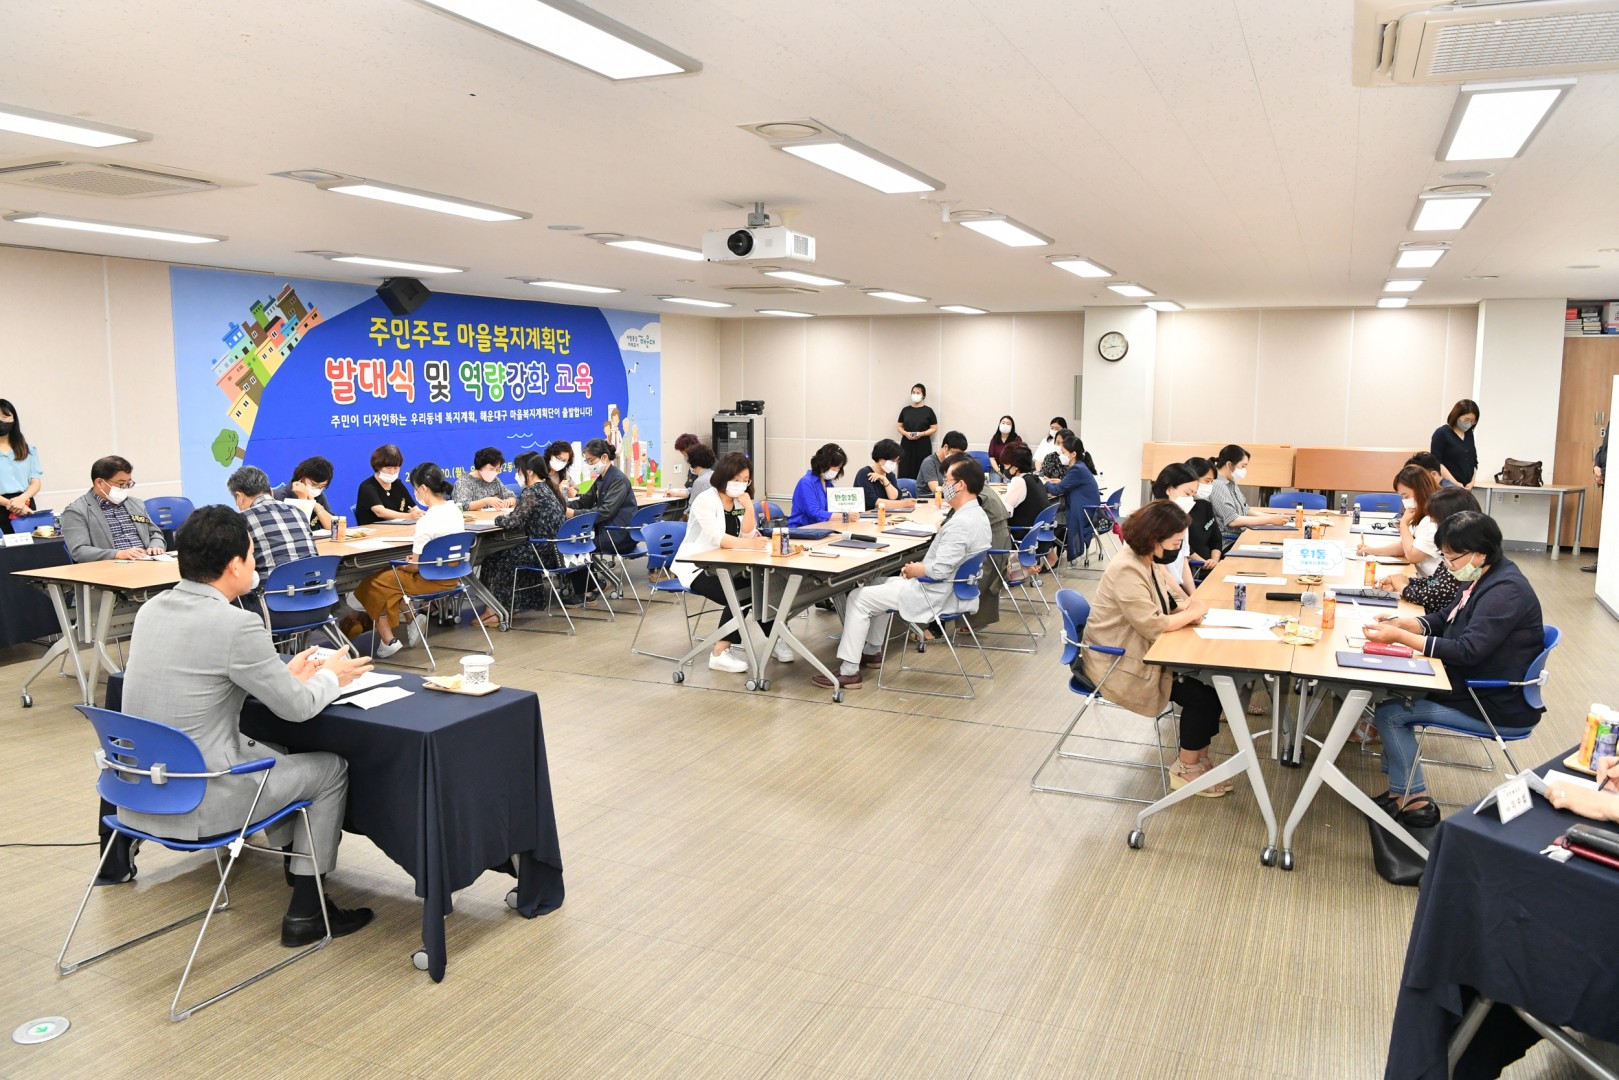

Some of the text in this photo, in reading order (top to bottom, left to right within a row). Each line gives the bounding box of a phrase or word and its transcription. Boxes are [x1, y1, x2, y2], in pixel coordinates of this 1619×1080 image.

[369, 317, 571, 355] 주민주도 마을복지계획단
[325, 357, 593, 405] 발대식 및 역량강화 교육
[330, 406, 593, 429] 주민이 디자인하는 우리동네 복지계획, 해운대구 마을복지계획단이 출발합니다!
[1300, 548, 1326, 560] 우1동
